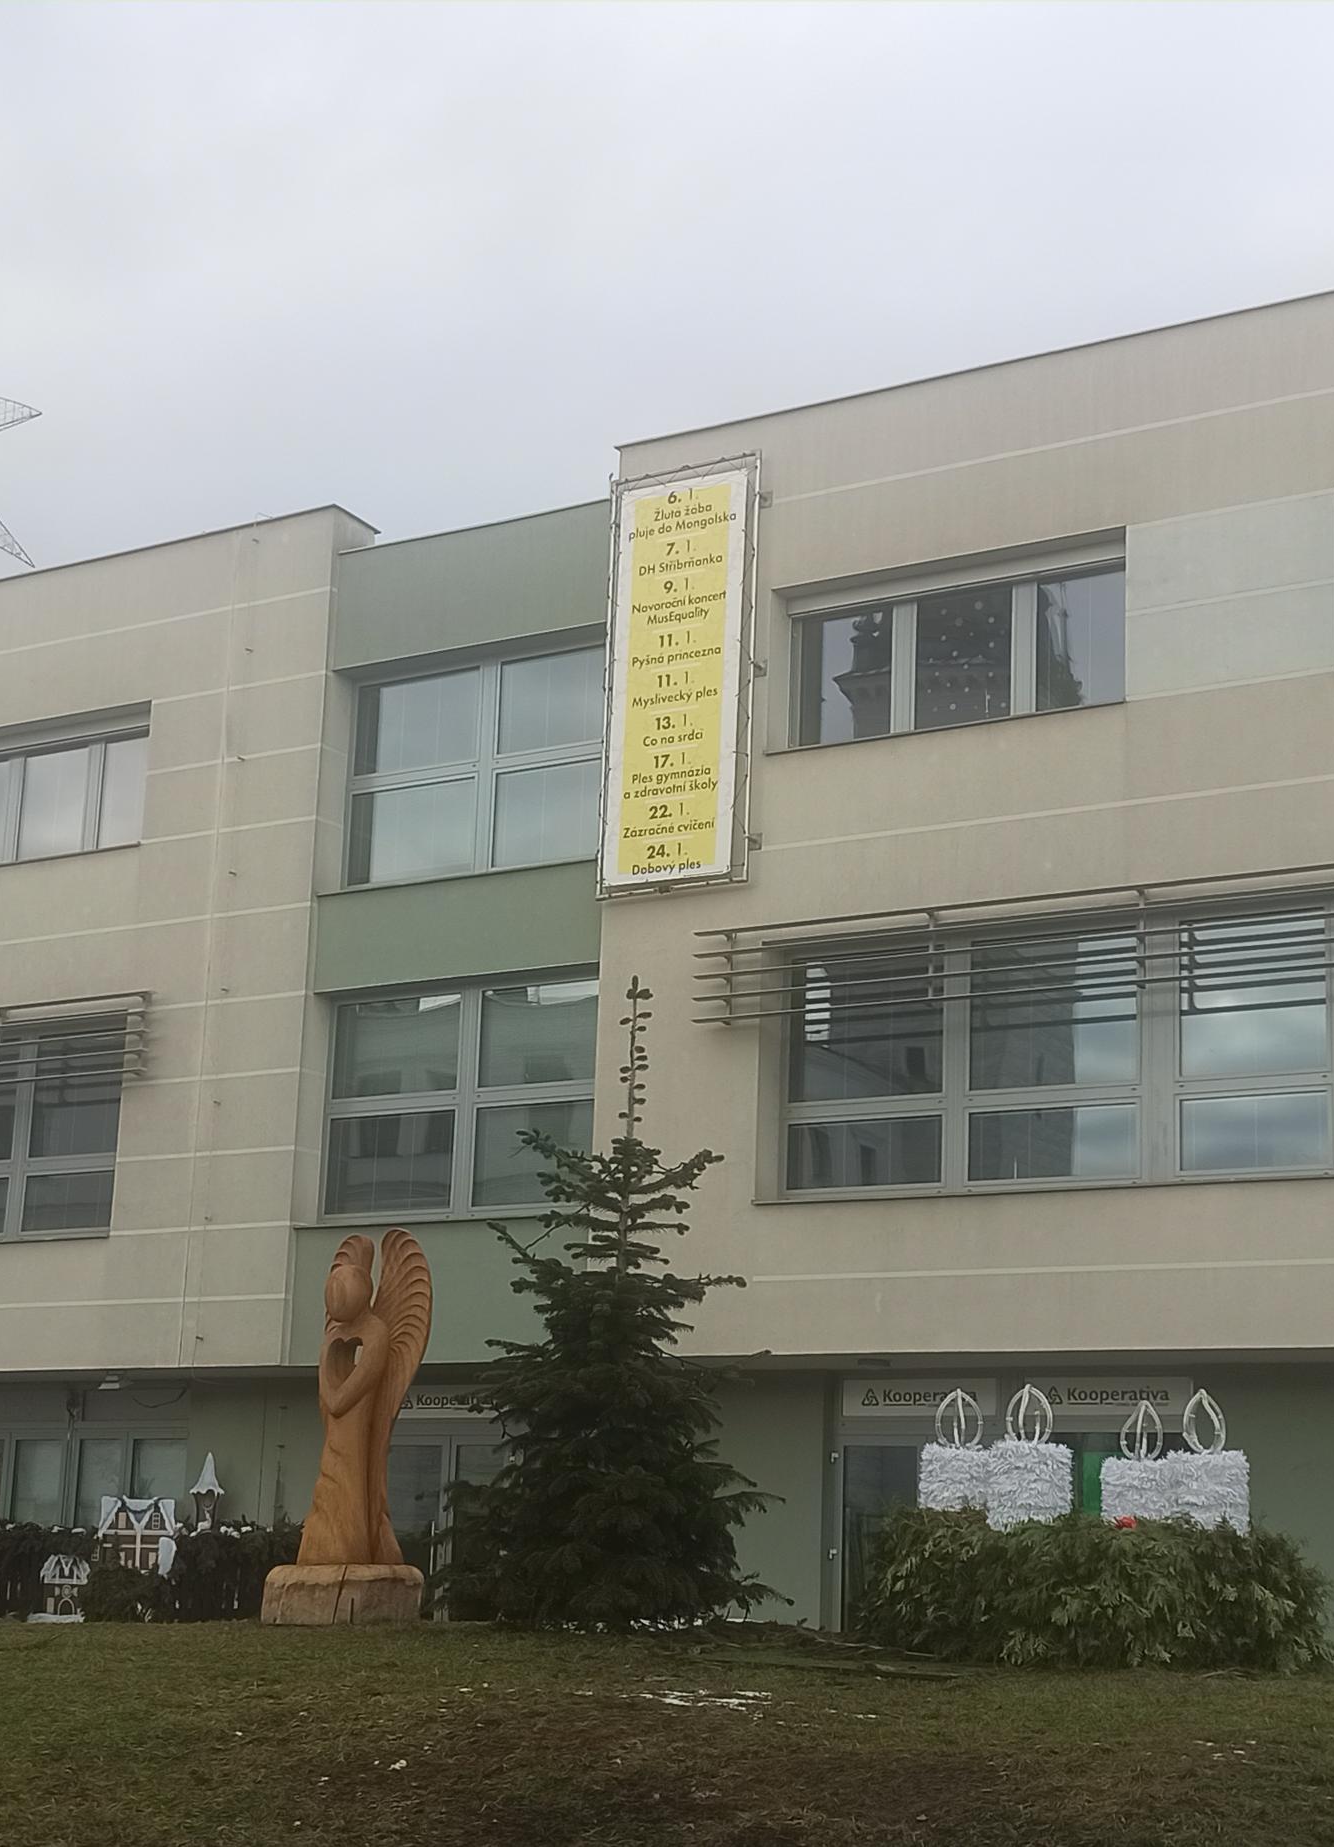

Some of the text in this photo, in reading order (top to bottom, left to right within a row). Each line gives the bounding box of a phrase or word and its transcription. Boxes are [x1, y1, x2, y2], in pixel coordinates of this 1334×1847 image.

[667, 487, 699, 504] 6. 1.
[654, 502, 713, 522] Žlutá žába
[628, 511, 737, 541] pluje do Mongolska
[666, 539, 697, 556] 7. 1.
[639, 560, 656, 576] DH
[663, 577, 695, 593] 9. 1.
[631, 590, 727, 614] Novoroční koncert
[647, 607, 710, 626] MusEquality
[659, 630, 697, 648] 11. 1.
[632, 646, 722, 669] Pyšná princezna
[657, 671, 695, 688] 11. 1.
[632, 685, 718, 709] Myslivecký ples
[655, 713, 693, 731] 13. 1.
[643, 729, 704, 747] Co na srdci
[653, 752, 692, 769] 17. 1.
[632, 765, 712, 785] Ples gymnázia
[623, 779, 719, 800] a zdravotní školy
[649, 802, 690, 820] 22. 1.
[623, 816, 715, 839] Zázračné cvičení
[647, 843, 688, 860] 24. 1.
[632, 858, 702, 876] Dobový ples
[883, 1389, 976, 1405] Kooperaa
[1067, 1386, 1170, 1405] Kooperativa
